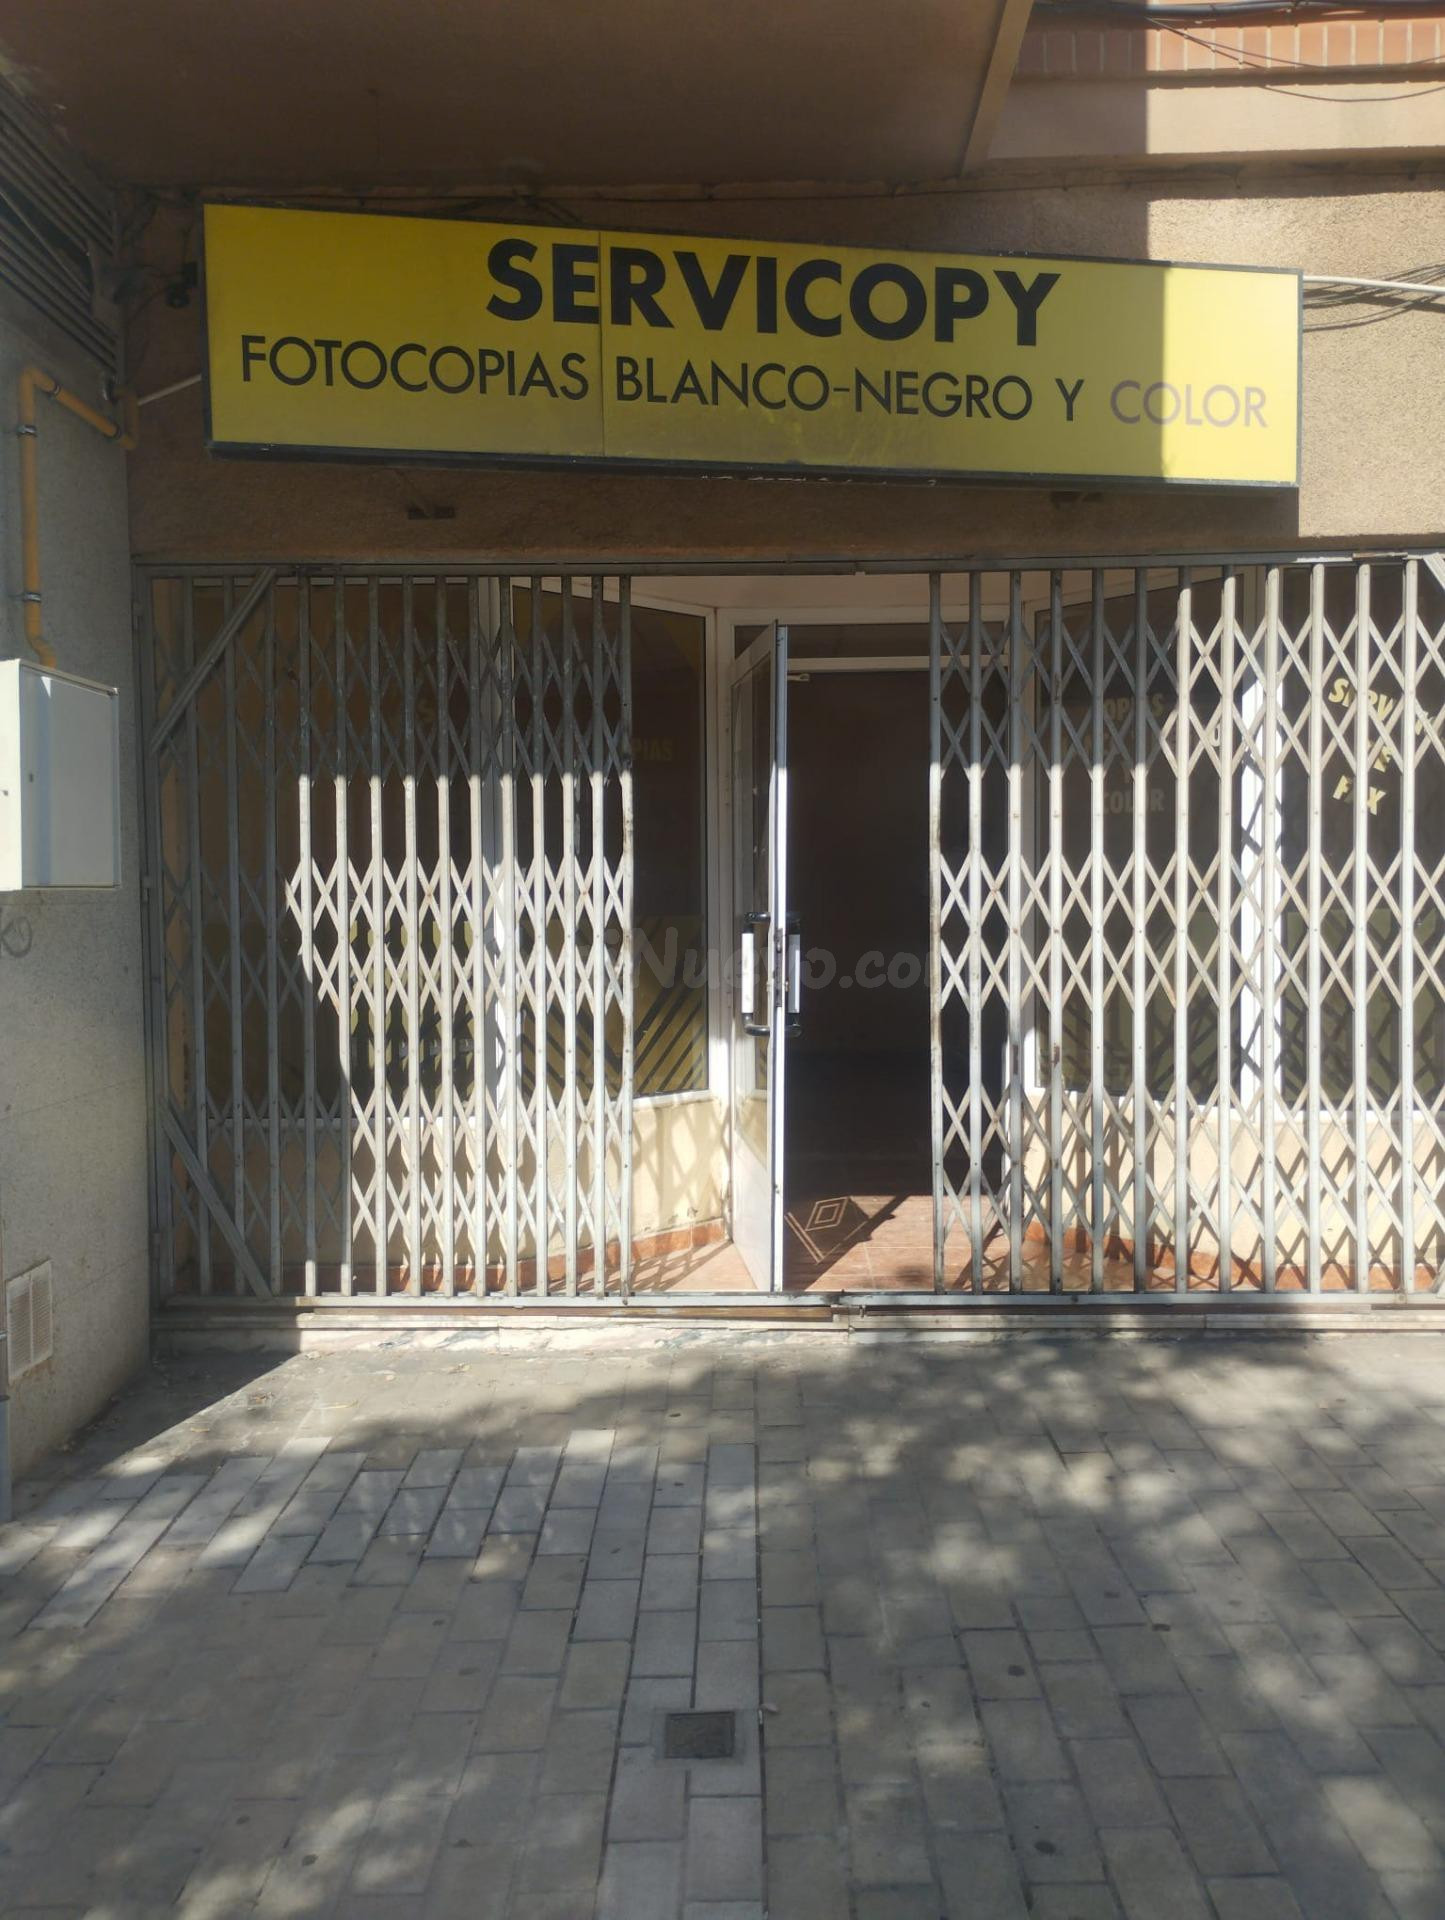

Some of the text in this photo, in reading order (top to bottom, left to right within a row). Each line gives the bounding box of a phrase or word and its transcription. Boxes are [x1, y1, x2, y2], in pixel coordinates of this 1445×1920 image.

[486, 238, 1062, 347] SERVICOPY
[241, 334, 1269, 428] FOTOCOPIAS BLANCO-NEGRO Y COLOR
